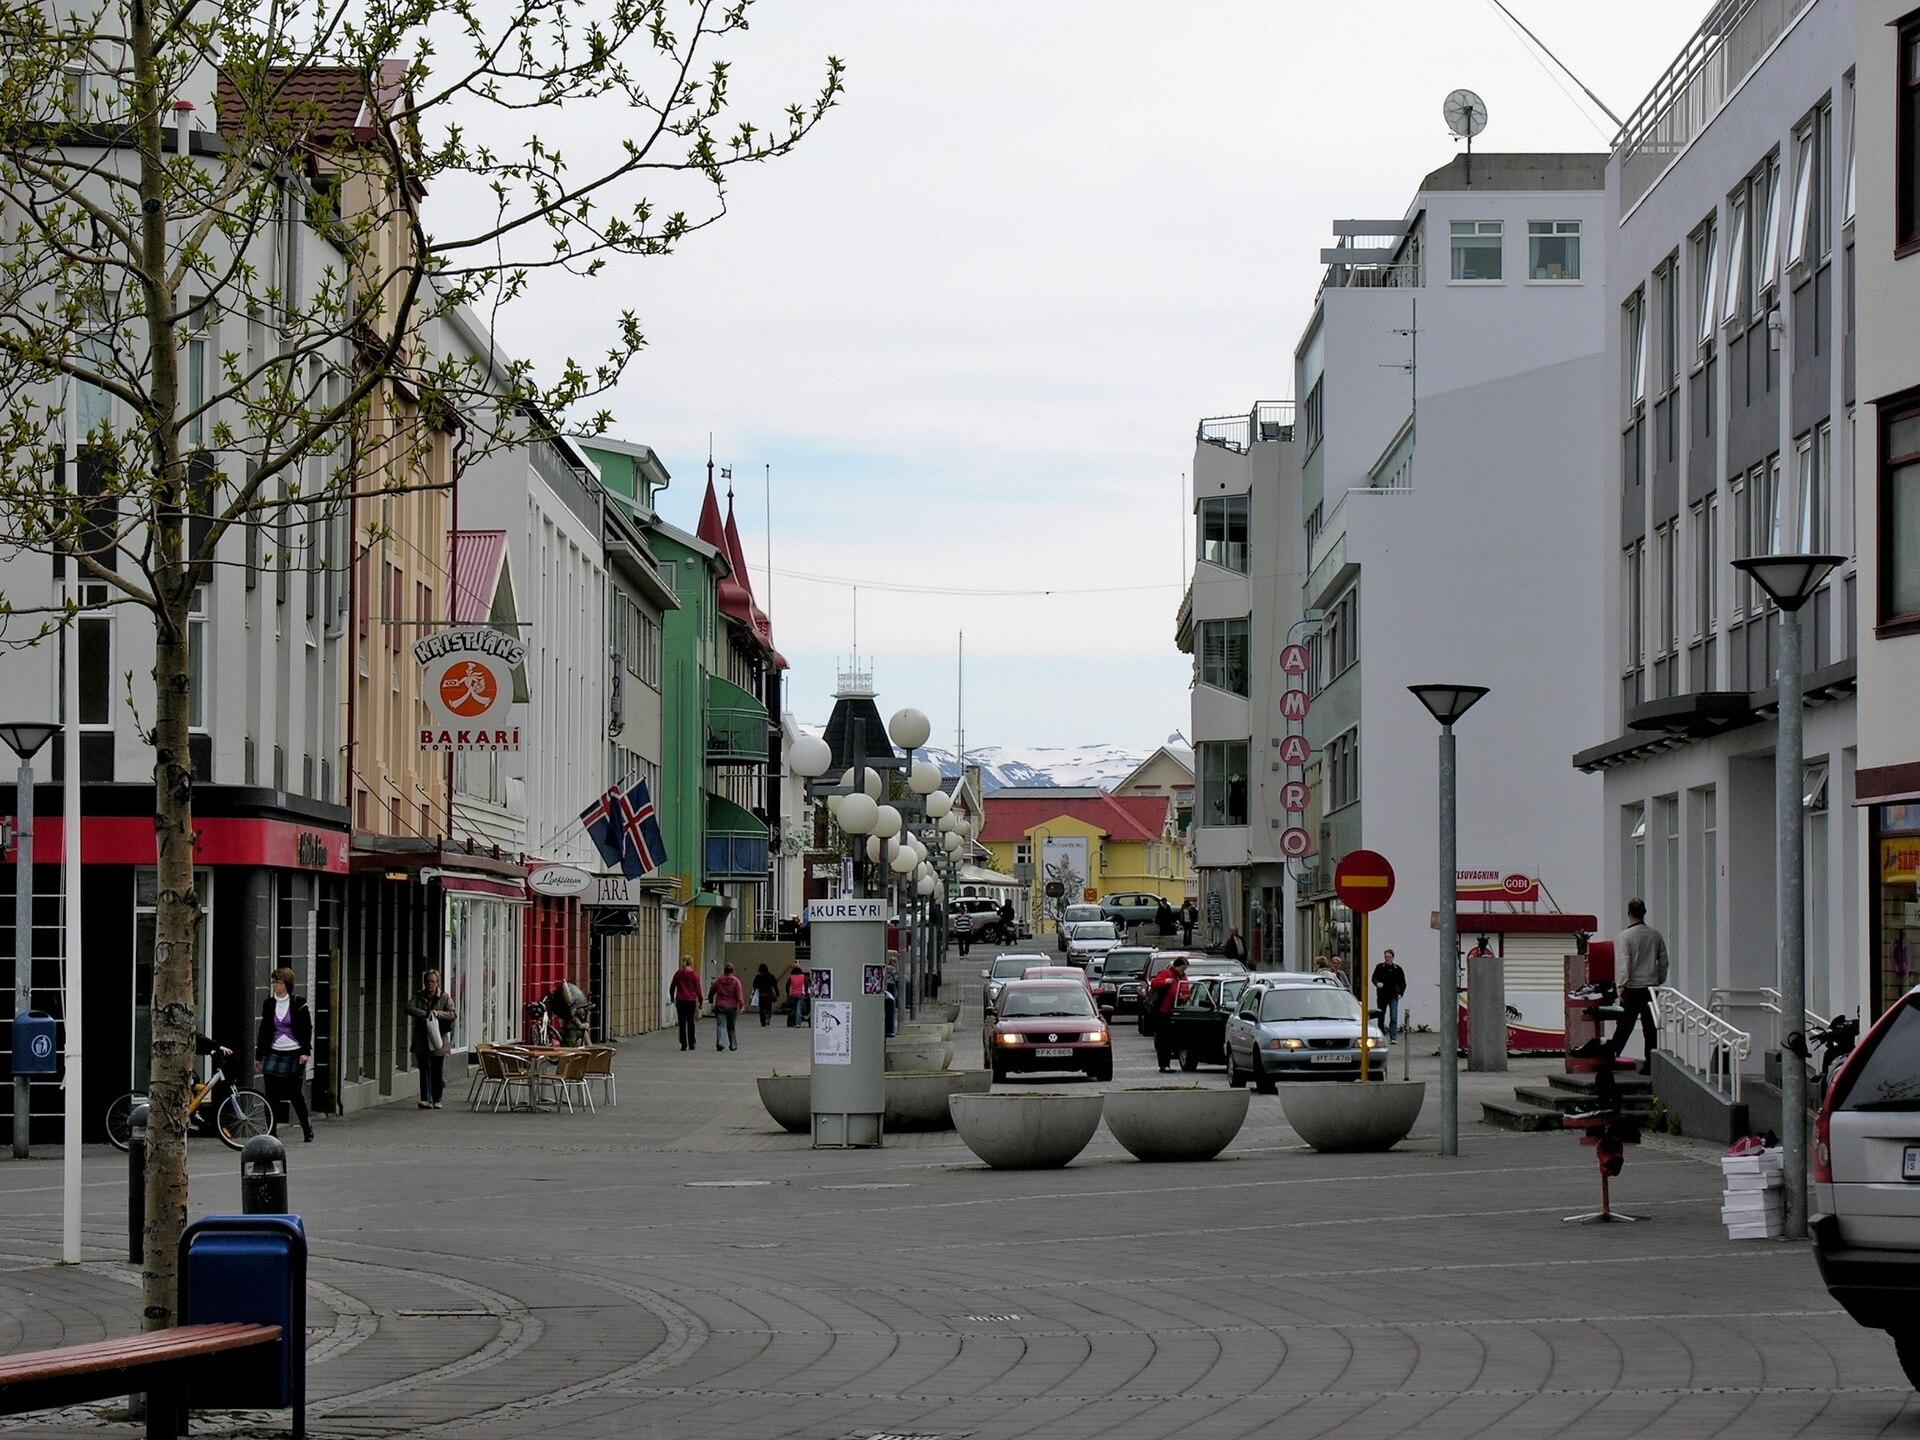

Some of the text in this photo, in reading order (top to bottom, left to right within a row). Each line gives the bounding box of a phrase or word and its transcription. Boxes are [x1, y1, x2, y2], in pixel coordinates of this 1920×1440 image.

[414, 631, 525, 666] KRISTJÁNS
[420, 726, 520, 744] BAKARÍ
[1283, 648, 1307, 855] AMARO
[597, 878, 629, 903] JARA
[810, 905, 881, 917] AKUREYRI
